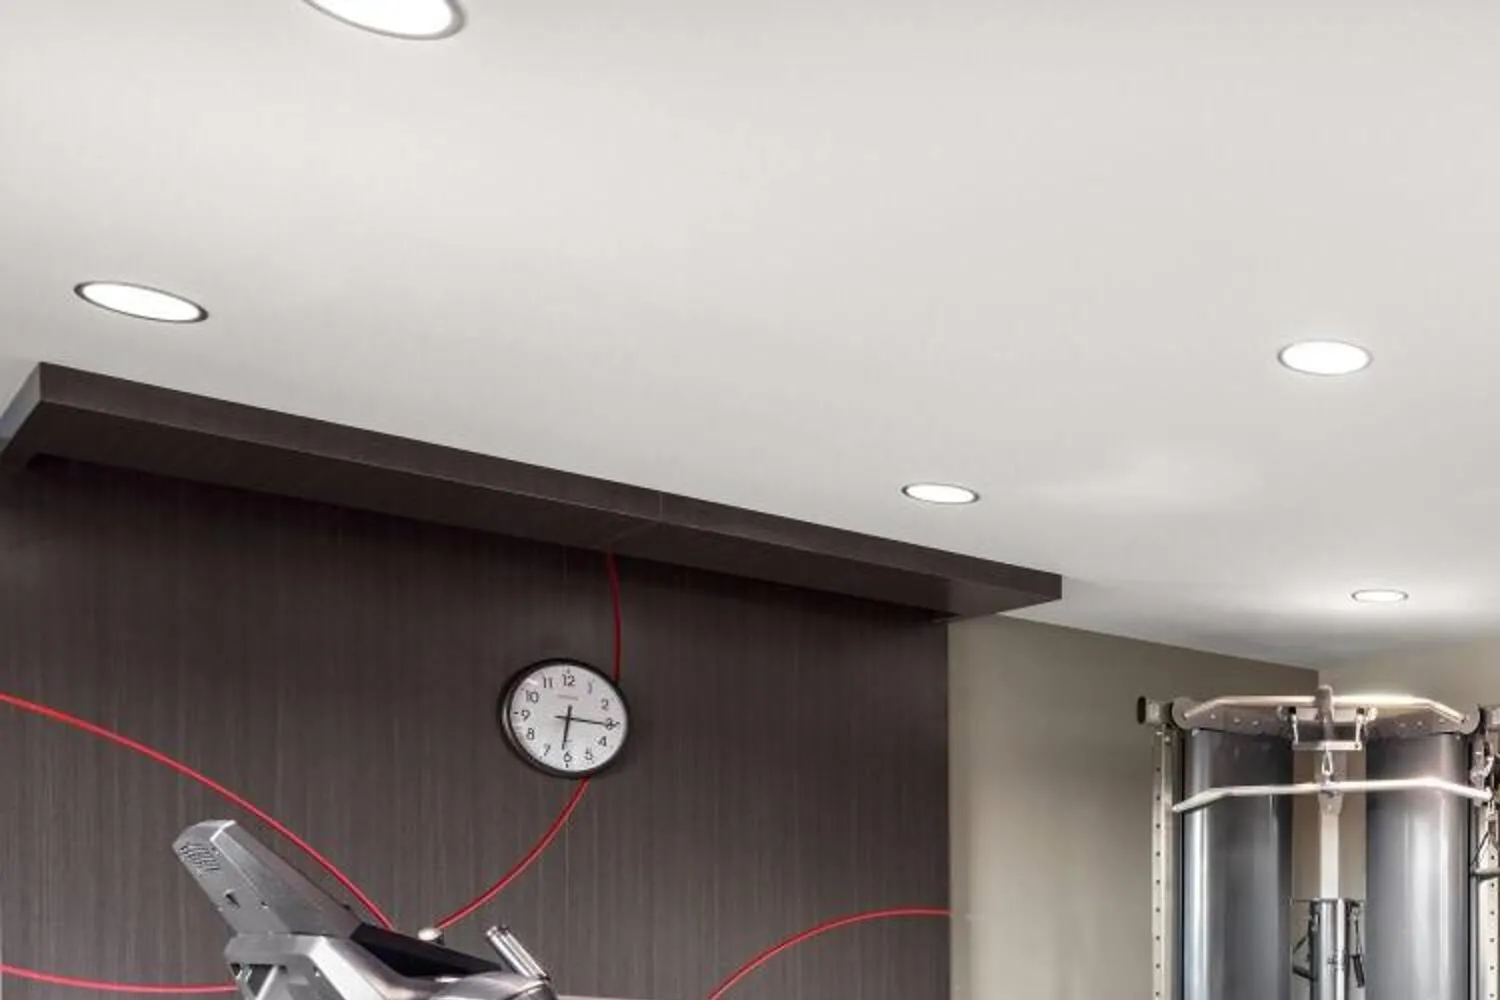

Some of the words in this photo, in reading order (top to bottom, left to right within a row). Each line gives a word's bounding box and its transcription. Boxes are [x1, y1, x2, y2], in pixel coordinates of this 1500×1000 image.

[542, 676, 554, 688] 11
[562, 674, 576, 687] 12
[525, 690, 539, 704] 10
[601, 699, 609, 711] 2
[520, 710, 531, 721] 9
[526, 728, 535, 741] 8
[563, 751, 573, 762] 6
